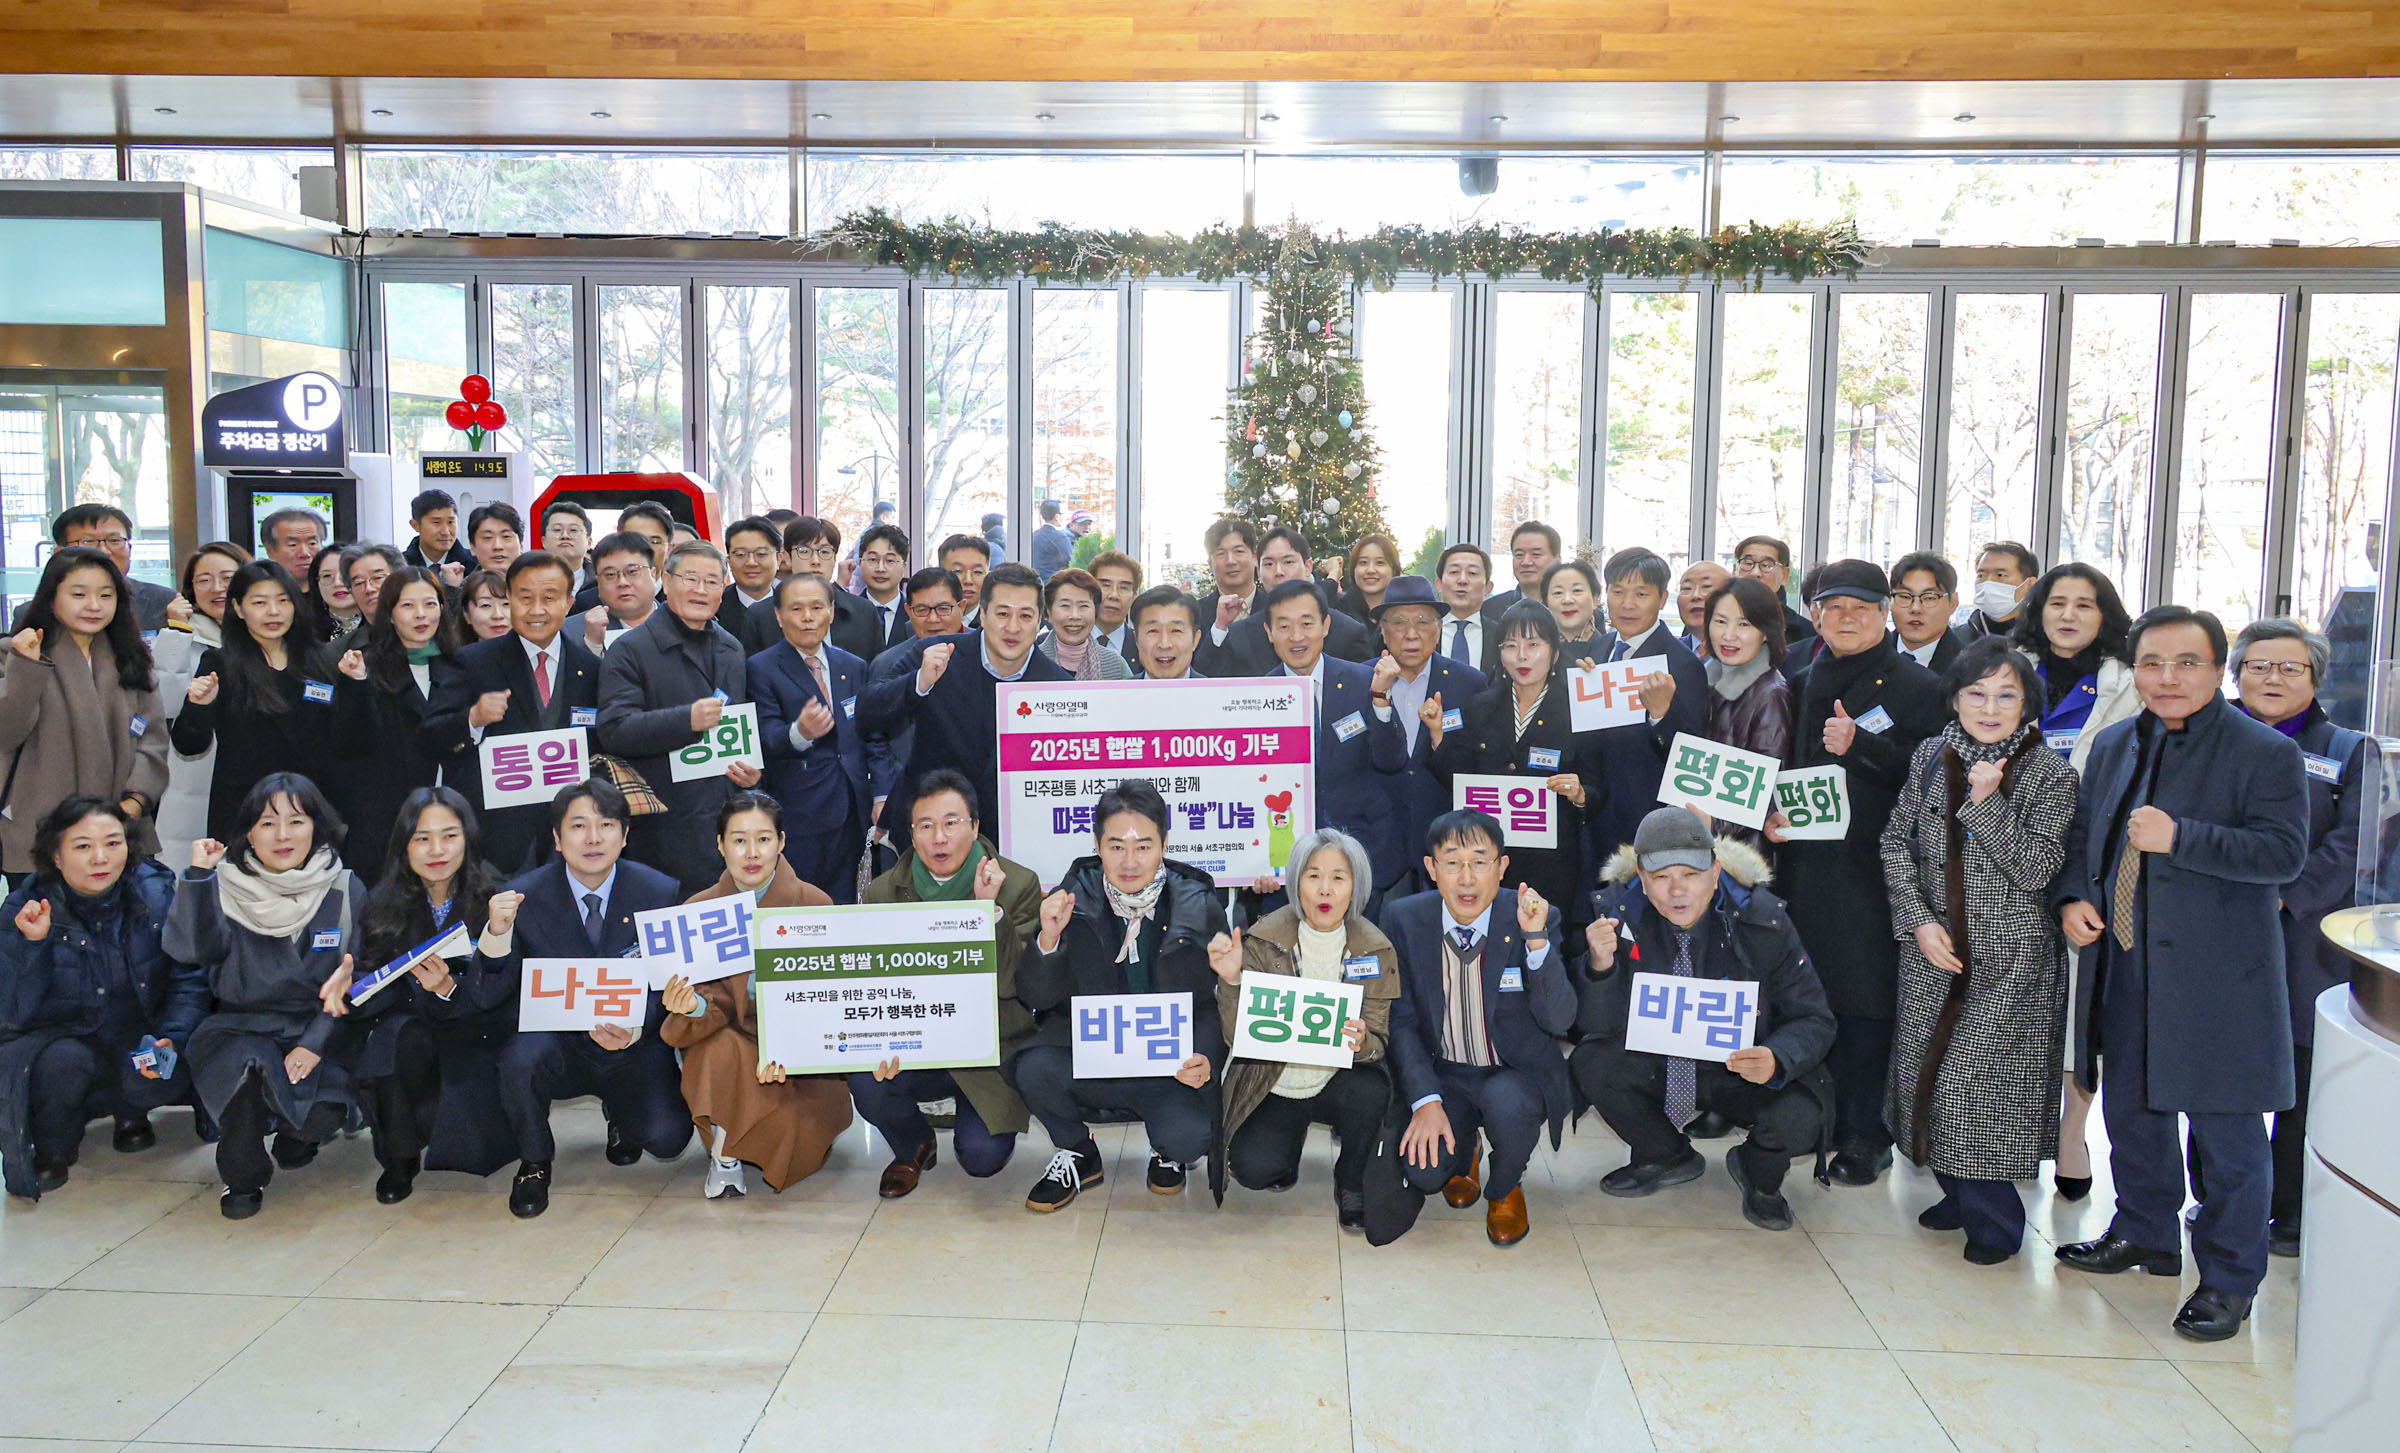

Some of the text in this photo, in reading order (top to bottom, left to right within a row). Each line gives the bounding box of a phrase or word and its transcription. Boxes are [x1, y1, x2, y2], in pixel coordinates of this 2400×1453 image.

[303, 384, 327, 421] P
[220, 432, 327, 451] 주차요금 정산기
[426, 461, 446, 474] 사랑의
[448, 461, 462, 473] 온도
[1034, 701, 1088, 713] 사랑의열매
[1263, 697, 1288, 711] 서초
[1030, 733, 1280, 763] 2025년 햅쌀 1,000Kg 기부
[492, 739, 581, 792] 통일
[1673, 745, 1766, 810] 평화
[1025, 780, 1077, 798] 민주평통
[1175, 777, 1200, 794] 함께
[1776, 775, 1842, 828] 평화
[1053, 804, 1100, 834] 따뜻
[1464, 786, 1547, 832] 통일
[1205, 843, 1245, 852] 서초구협의회
[644, 902, 753, 964] 바람
[789, 925, 826, 933] 사랑의열매
[959, 920, 978, 930] 서초
[773, 949, 985, 972] 2025년 햅쌀 1,000kg 기부
[531, 968, 642, 1017] 나눔
[785, 987, 917, 1003] 서초구민을 위한 공익 나눔,
[844, 1003, 957, 1021] 모두가 행복한 하루
[1247, 986, 1350, 1047] 평화
[1638, 984, 1752, 1050] 바람
[1080, 1003, 1187, 1060] 바람
